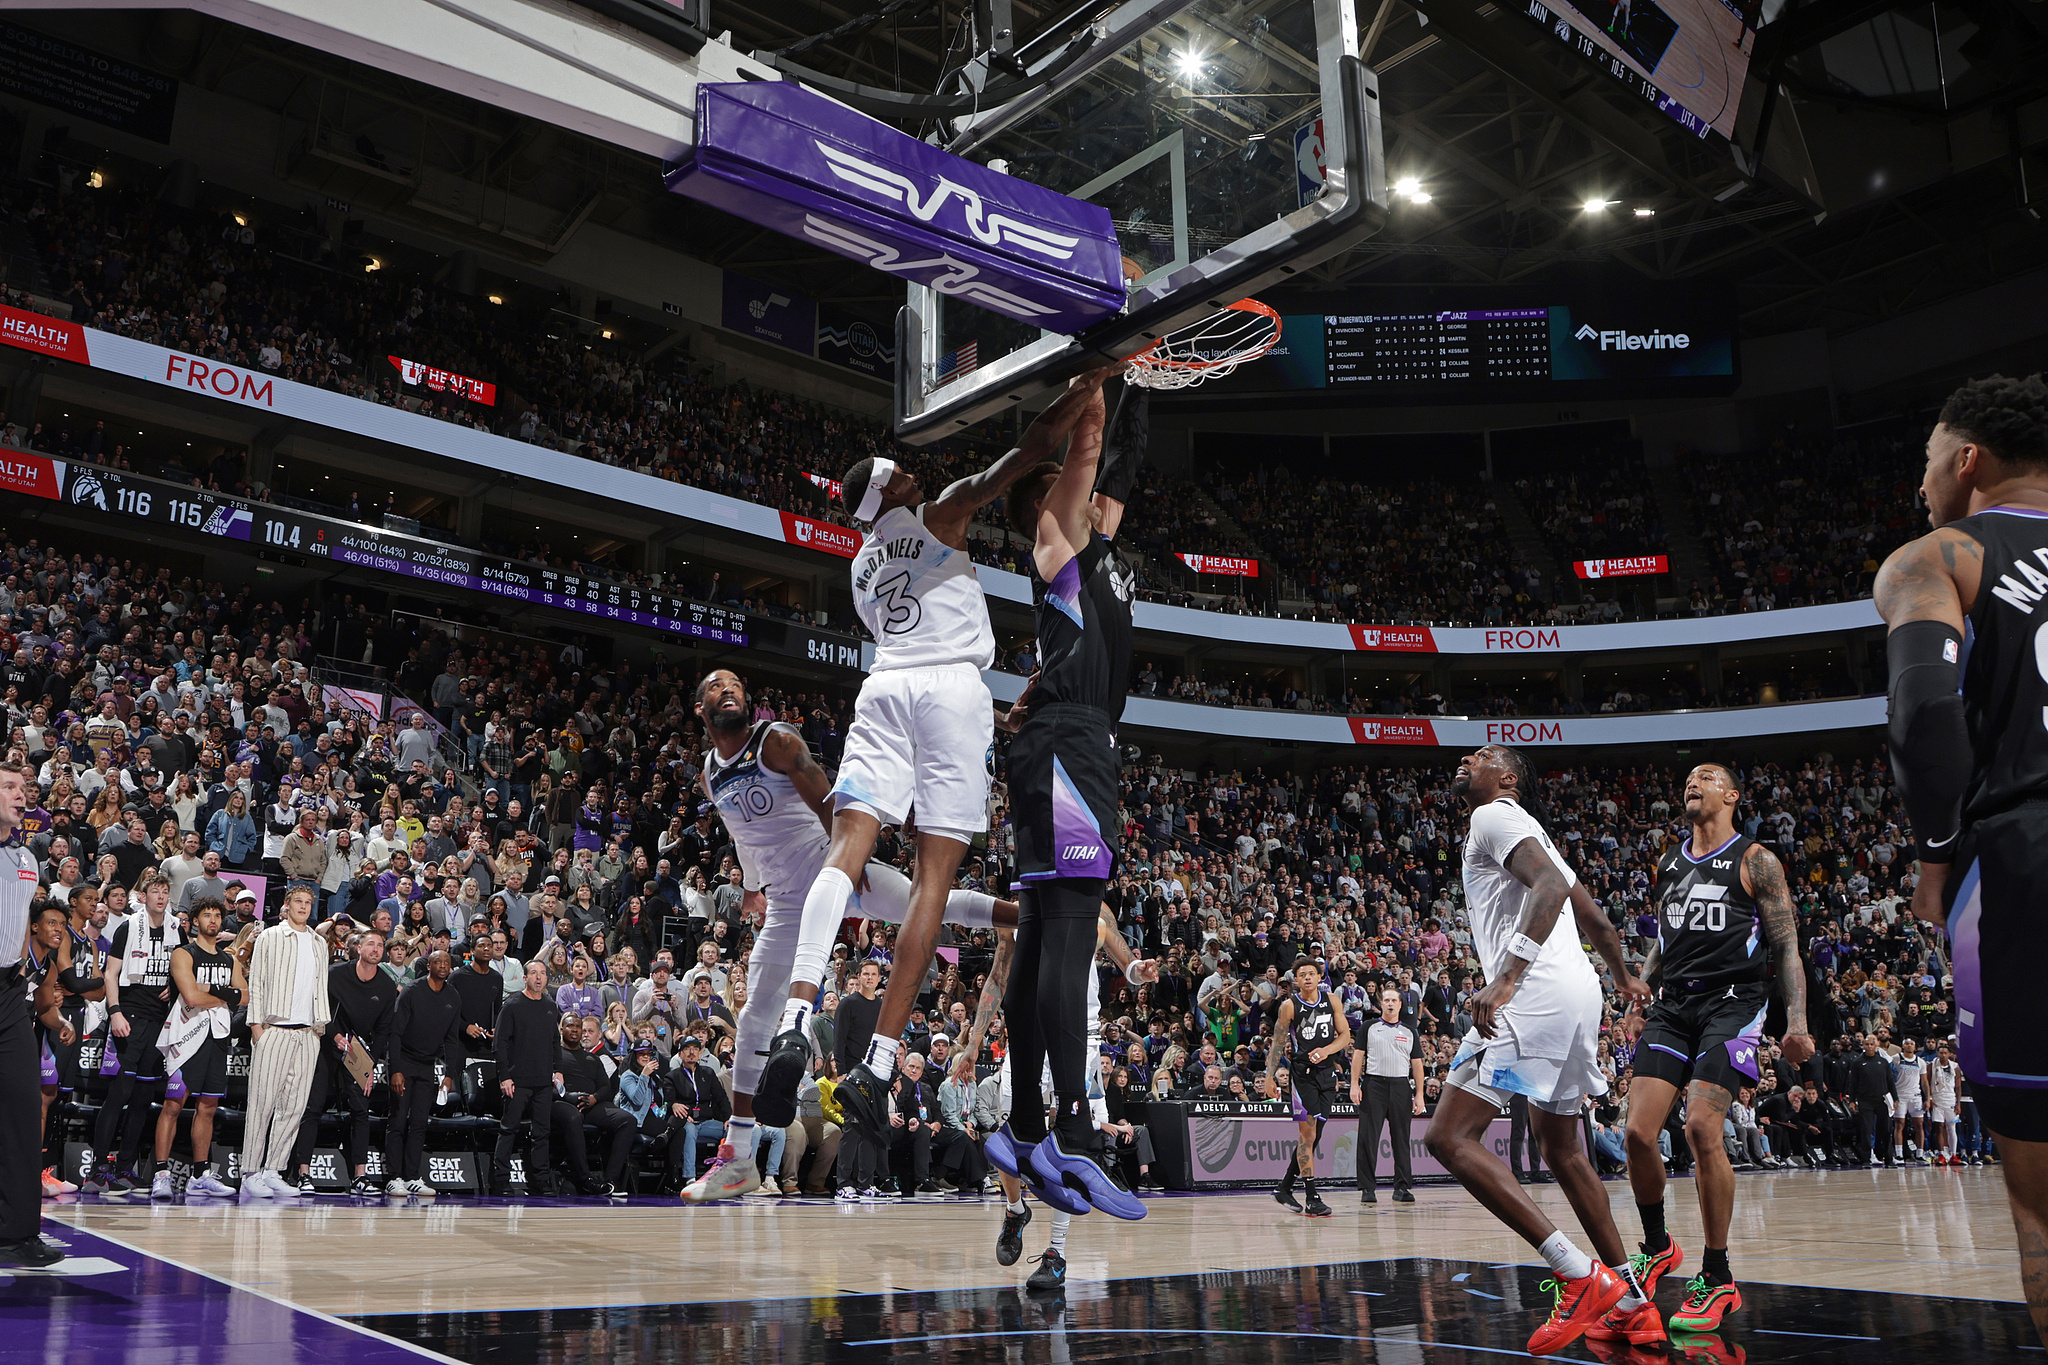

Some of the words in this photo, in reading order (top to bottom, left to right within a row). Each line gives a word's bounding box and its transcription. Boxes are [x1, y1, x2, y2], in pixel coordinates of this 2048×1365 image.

[1529, 0, 1548, 23] MIN
[6, 28, 38, 48] SOS
[40, 40, 86, 64] DELTA
[90, 56, 109, 71] TO
[1578, 35, 1593, 56] 116
[1610, 59, 1624, 78] 10.5
[1628, 73, 1633, 83] 5
[1641, 81, 1656, 101] 115
[1681, 109, 1696, 129] UTA
[3, 317, 68, 344] HEALTH
[754, 325, 782, 340] SEATGEEK
[852, 330, 874, 349] UTAH
[1600, 329, 1689, 350] Filevine
[2, 331, 38, 345] UNIVERSITY
[49, 343, 66, 352] UTAH
[849, 357, 875, 371] SEATGEEK
[167, 355, 272, 406] FROM
[429, 369, 483, 394] HEALTH
[80, 467, 92, 475] FLS
[110, 474, 122, 482] TOL
[117, 488, 151, 516] 116
[204, 494, 214, 503] TOL
[236, 502, 248, 510] FLS
[169, 500, 202, 527] 115
[204, 506, 222, 530] BONUS
[266, 520, 300, 548] 10.4
[317, 530, 324, 540] 5
[816, 529, 854, 547] HEALTH
[310, 543, 328, 555] 4TH
[341, 536, 377, 552] 44/100
[379, 544, 406, 559] (44%)
[815, 540, 836, 549] UNIVERSITY
[344, 551, 373, 565] 46/91
[375, 556, 400, 571] (51%)
[413, 552, 442, 566] 20/52
[444, 558, 470, 573] (38%)
[856, 538, 924, 592] McDANIELS
[1206, 557, 1248, 569] HEALTH
[1608, 557, 1656, 569] HEALTH
[412, 565, 440, 579] 14/35
[441, 572, 468, 586] (40%)
[483, 567, 504, 579] 8/14
[506, 572, 529, 586] (57%)
[588, 581, 599, 589] REB
[482, 580, 502, 592] 9/14
[504, 584, 529, 599] (64%)
[651, 595, 662, 603] BLK
[545, 581, 553, 590] 11
[565, 585, 576, 595] 29
[587, 590, 598, 600] 40
[608, 594, 619, 604] 35
[631, 600, 640, 608] 17
[653, 604, 658, 613] 4
[674, 609, 679, 617] 7
[693, 613, 703, 622] 37
[712, 617, 723, 627] 114
[731, 621, 743, 631] 113
[690, 603, 707, 613] BENCH
[875, 570, 922, 634] 3
[543, 594, 553, 603] 15
[564, 598, 576, 608] 43
[586, 603, 597, 612] 58
[608, 607, 618, 617] 34
[631, 612, 637, 621] 3
[652, 617, 658, 626] 4
[670, 621, 680, 630] 20
[692, 625, 702, 635] 53
[711, 630, 723, 640] 113
[730, 634, 742, 643] 114
[1384, 633, 1423, 643] HEALTH
[1485, 630, 1560, 649] FROM
[808, 639, 834, 663] 9:41
[839, 646, 858, 668] PM
[1384, 726, 1423, 736] HEALTH
[1487, 723, 1562, 742] FROM
[732, 785, 773, 822] 10
[1062, 846, 1099, 860] UTAH
[1712, 859, 1732, 870] LVT
[1689, 901, 1726, 931] 20
[1320, 1024, 1329, 1038] 3
[429, 1157, 461, 1170] SEAT
[430, 1170, 465, 1182] GEEK
